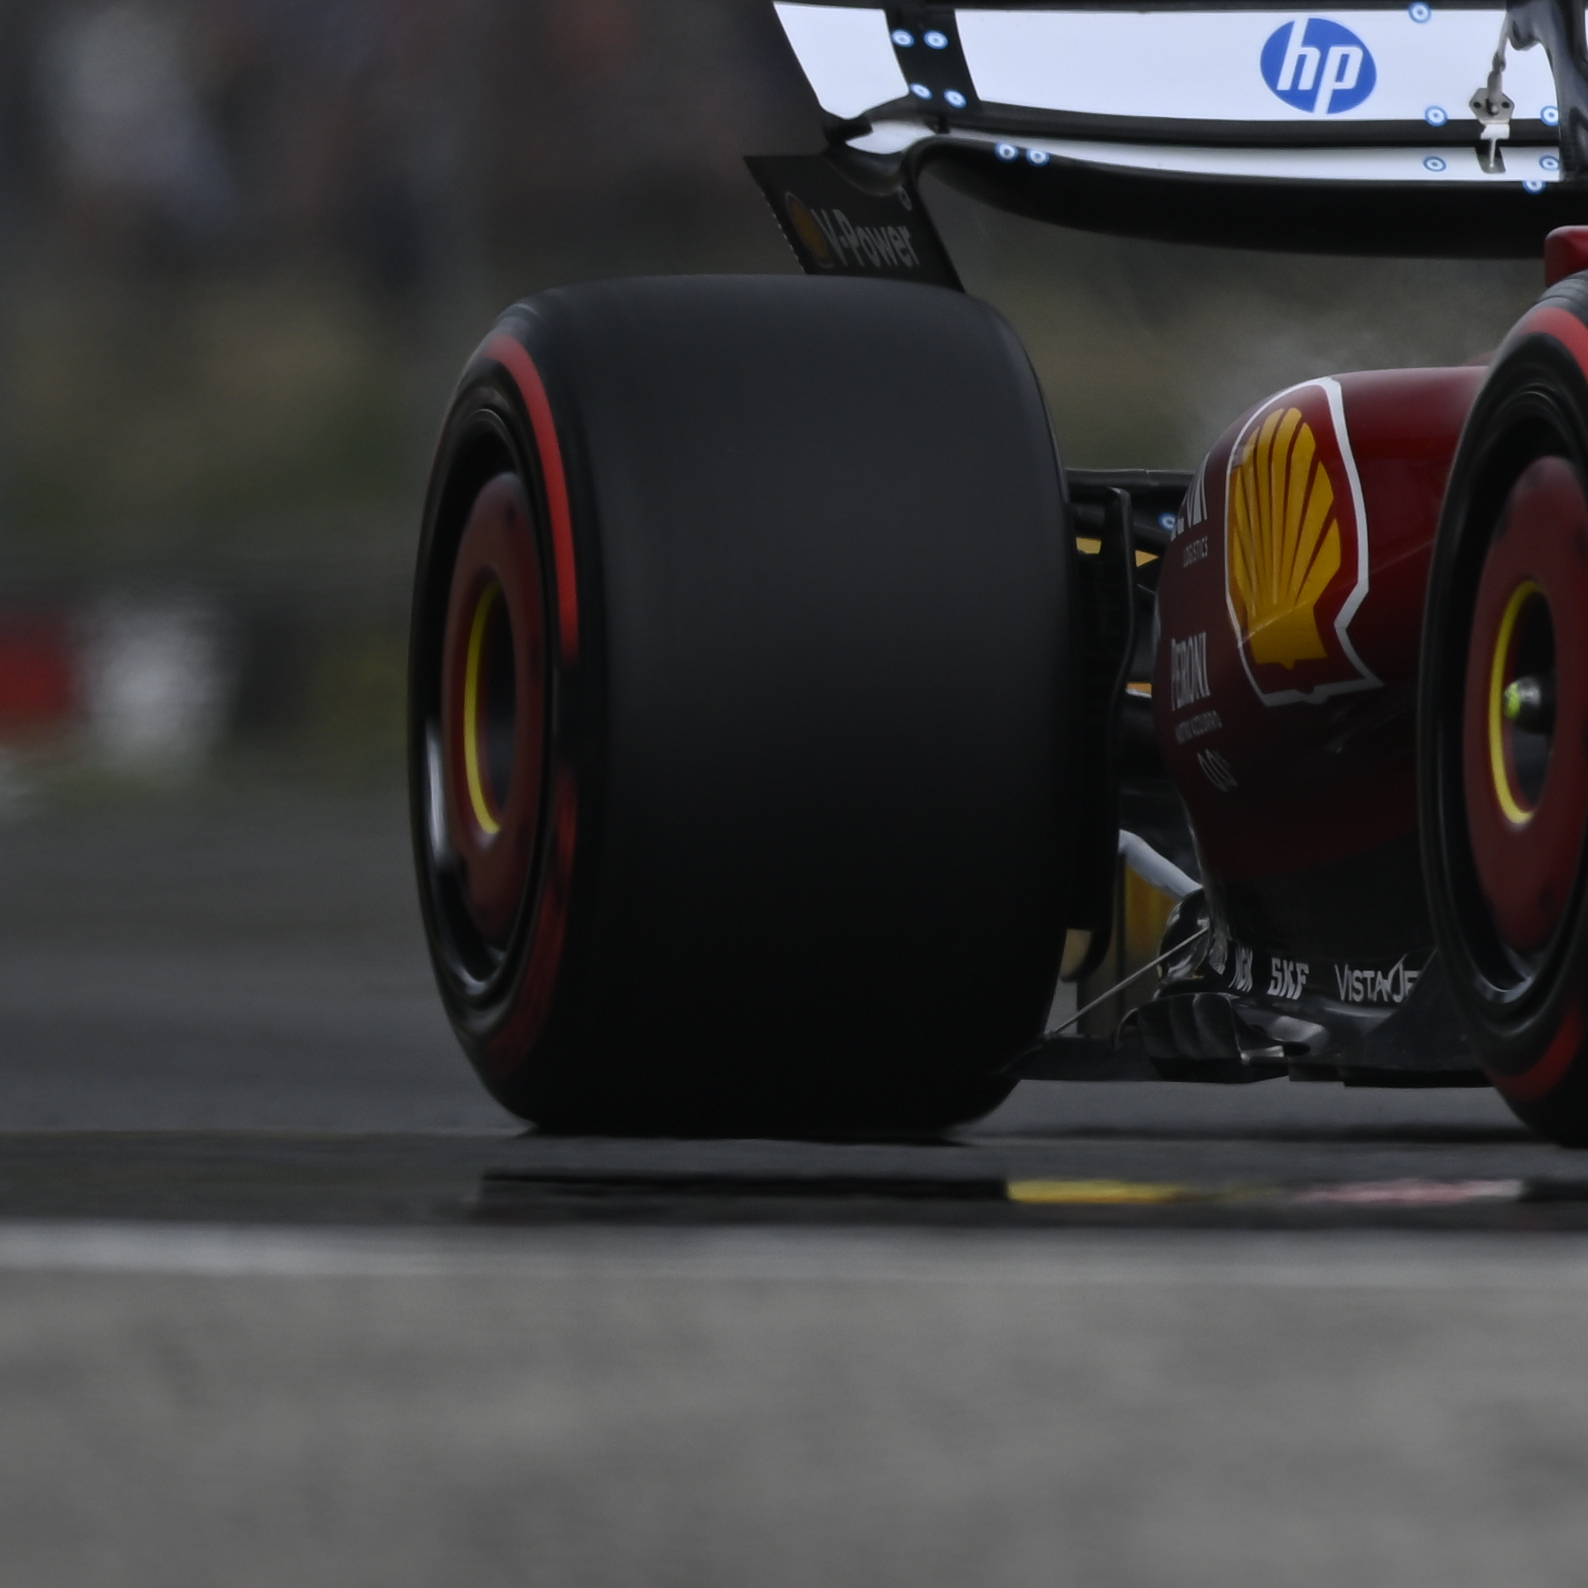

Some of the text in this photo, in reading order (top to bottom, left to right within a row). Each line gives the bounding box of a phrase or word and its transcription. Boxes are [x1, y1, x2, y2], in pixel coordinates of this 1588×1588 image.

[1270, 16, 1370, 114] hp
[811, 209, 919, 268] V-Power
[1266, 957, 1309, 1000] SKF
